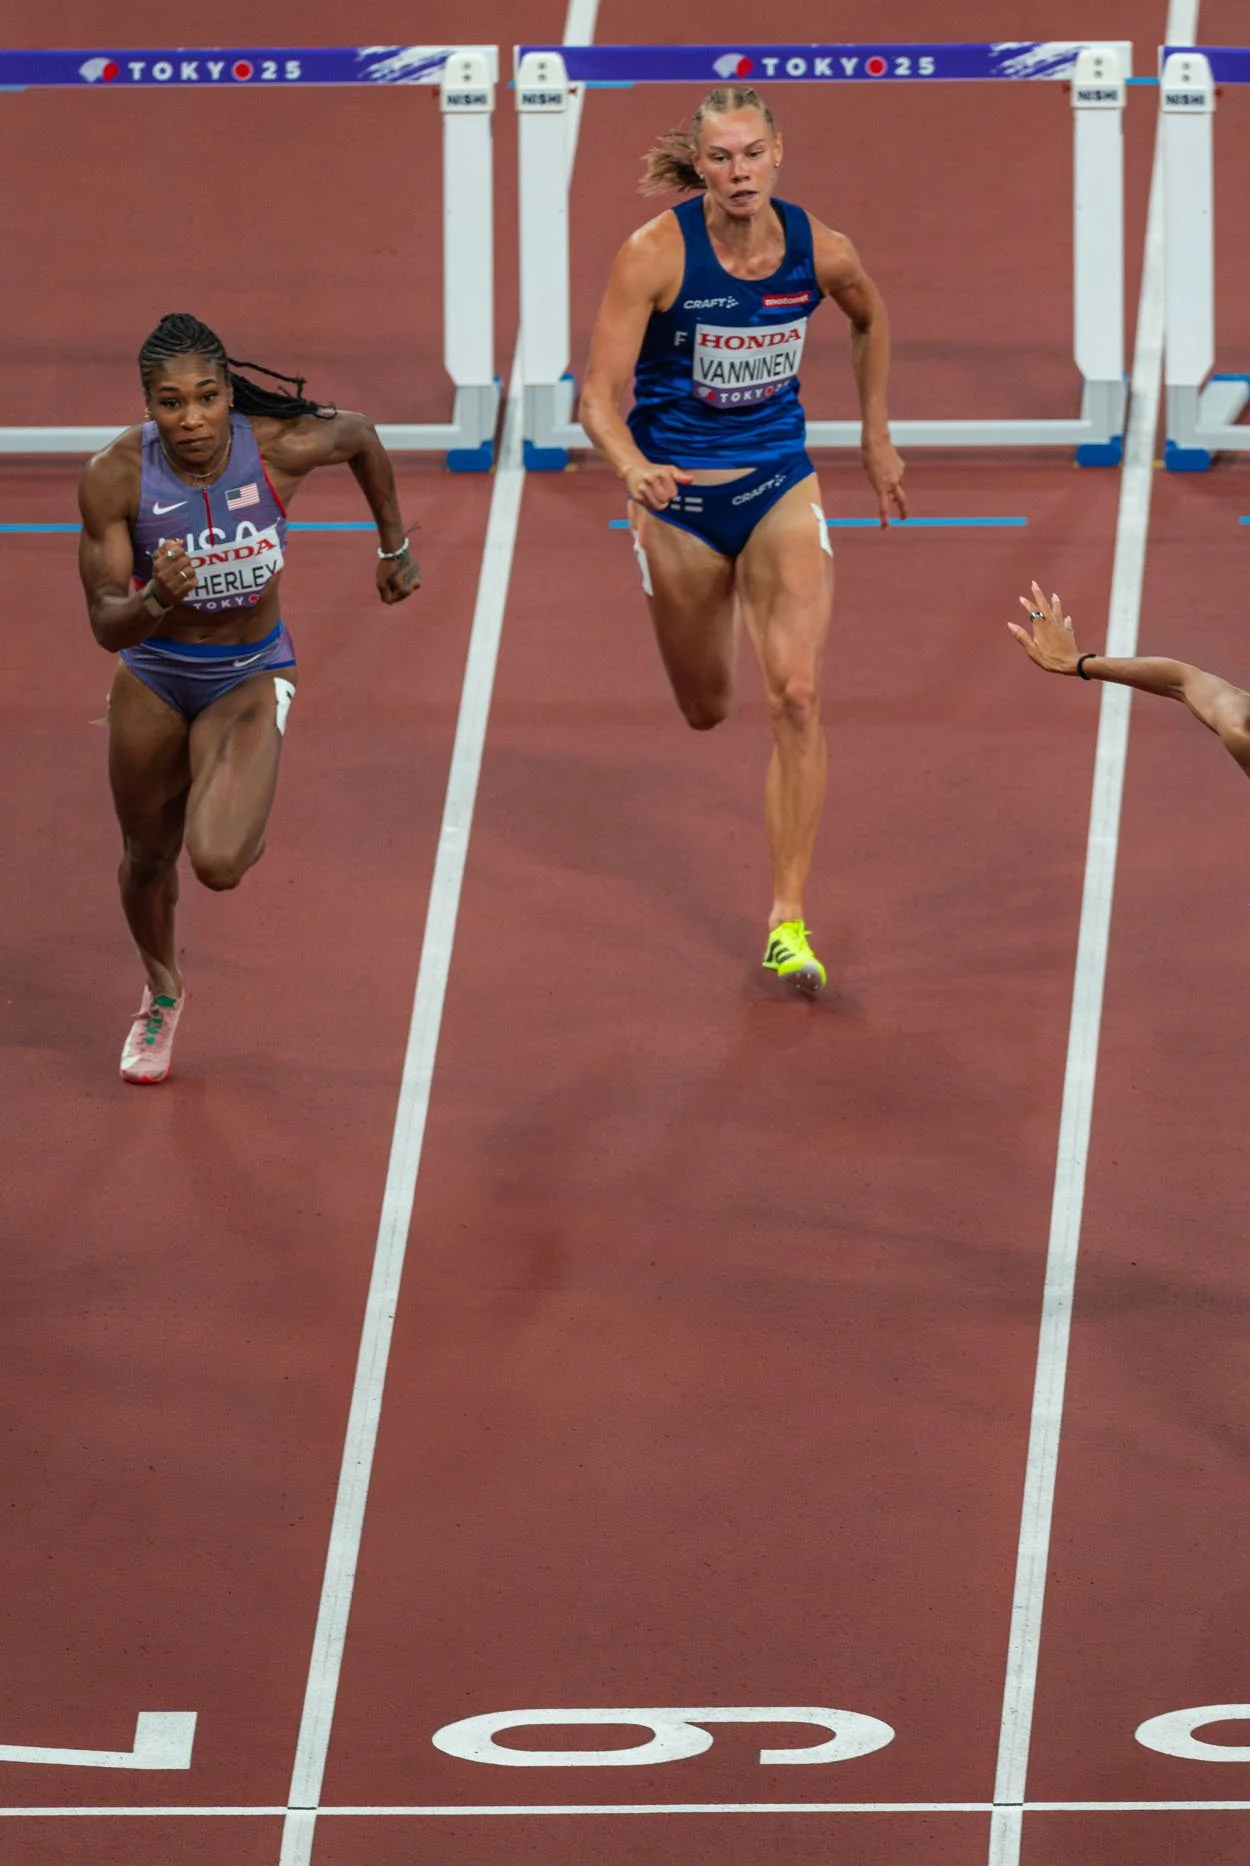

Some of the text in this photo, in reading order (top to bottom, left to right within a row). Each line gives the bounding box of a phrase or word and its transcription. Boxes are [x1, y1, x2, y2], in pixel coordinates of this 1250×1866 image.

[447, 94, 488, 105] NISHI
[522, 93, 562, 105] NISHI
[1078, 90, 1118, 101] NISHI
[1166, 95, 1205, 105] NISHI
[683, 297, 726, 310] CRAFT
[698, 328, 802, 351] HONDA
[699, 350, 798, 385] VANNINEN
[731, 479, 775, 506] CRAFT
[190, 537, 277, 569] ONDA
[431, 1706, 896, 1767] 6
